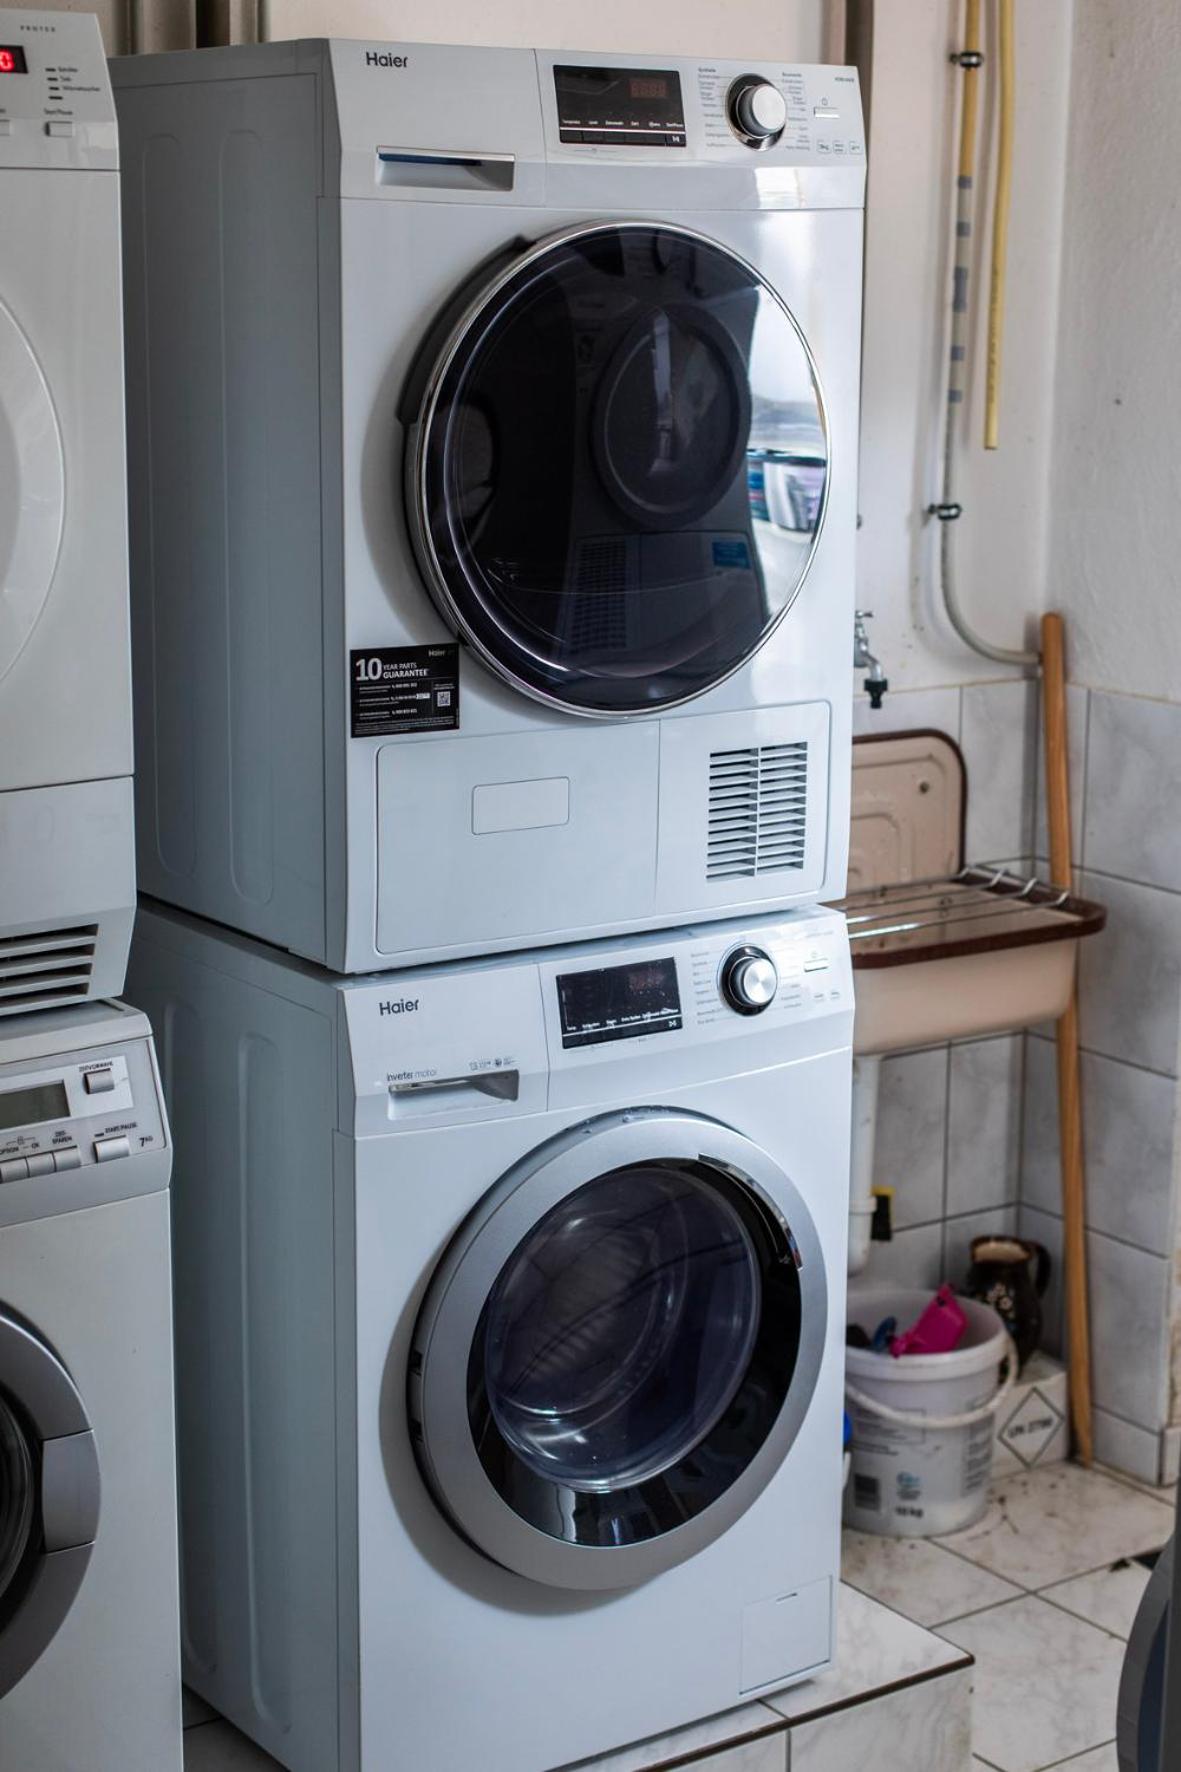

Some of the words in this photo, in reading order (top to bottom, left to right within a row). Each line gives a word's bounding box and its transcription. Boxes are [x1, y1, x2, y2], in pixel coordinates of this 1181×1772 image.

[366, 51, 408, 67] Haier
[428, 649, 445, 657] Haier
[355, 657, 382, 681] 10
[383, 663, 398, 671] YEAR
[383, 668, 430, 679] GUARANTEE
[379, 999, 419, 1016] Haier
